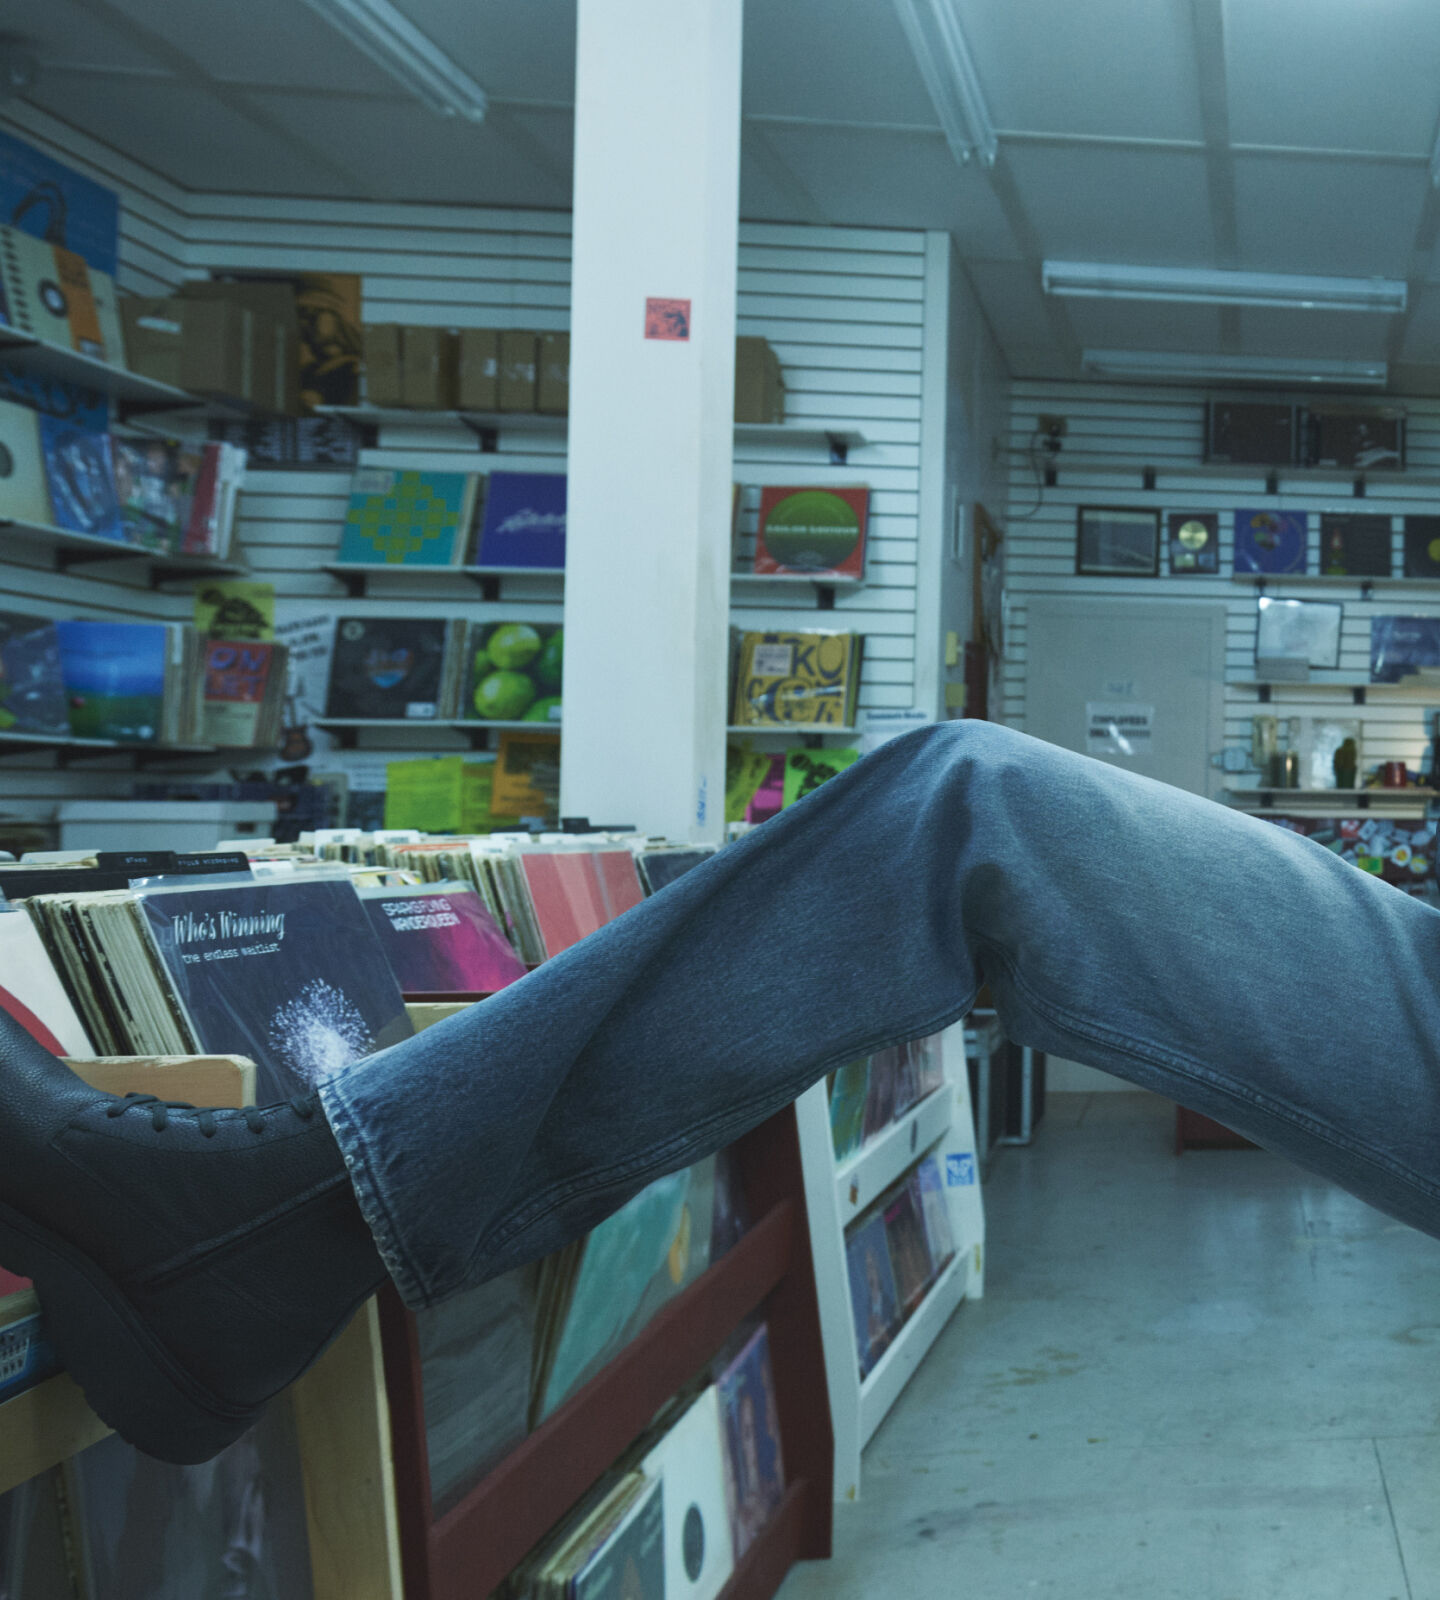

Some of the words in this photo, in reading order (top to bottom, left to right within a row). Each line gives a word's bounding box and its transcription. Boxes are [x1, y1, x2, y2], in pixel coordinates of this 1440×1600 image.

[171, 911, 217, 945] Who's
[218, 910, 285, 941] Winning
[181, 953, 201, 964] the
[203, 948, 239, 961] endless
[240, 942, 281, 956] waitlist
